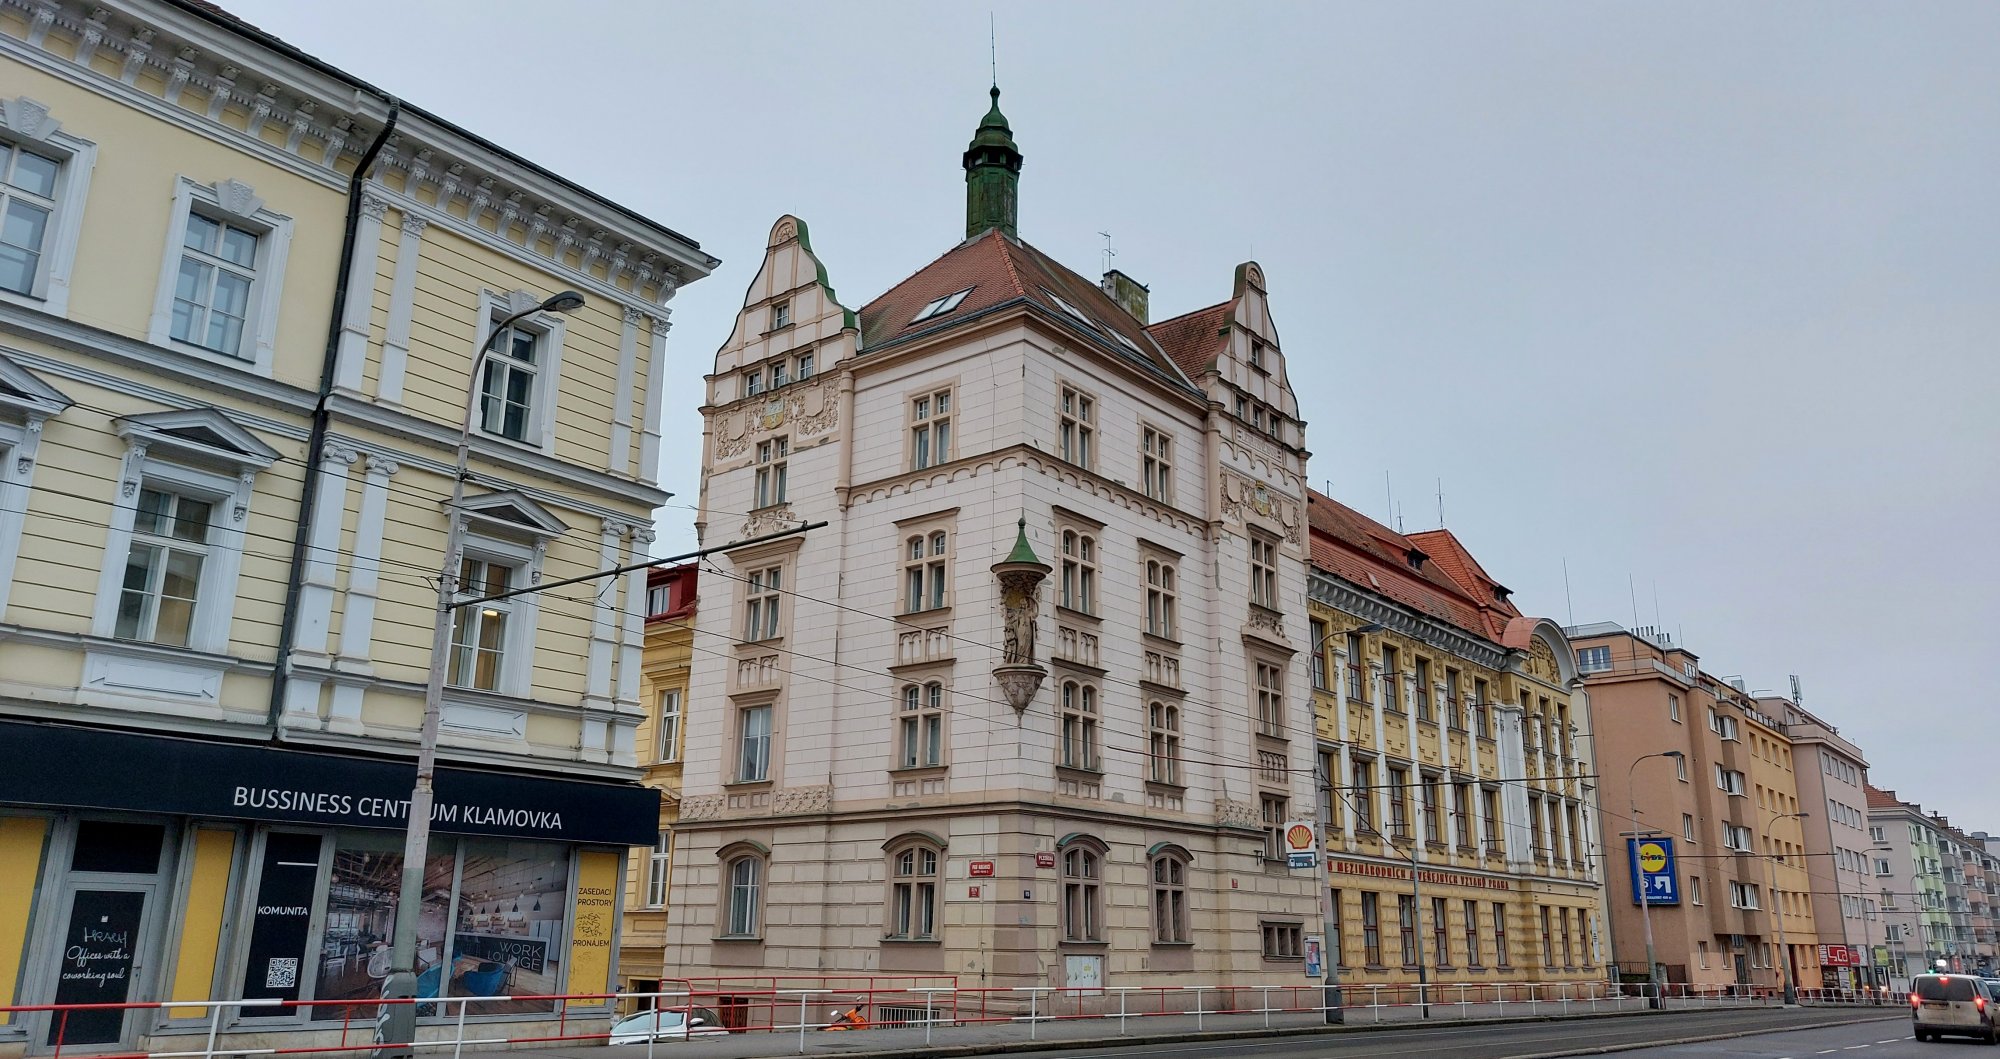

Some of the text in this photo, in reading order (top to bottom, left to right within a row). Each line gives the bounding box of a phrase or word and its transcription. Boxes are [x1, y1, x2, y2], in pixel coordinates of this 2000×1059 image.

[234, 786, 563, 830] BUSSINESS CENTUM KLAMOVKA
[578, 887, 612, 896] ZASEDACÍ
[577, 898, 613, 907] PROSTORY
[257, 905, 308, 916] KOMUNITA
[499, 941, 542, 958] WORK
[572, 938, 610, 947] PRONÁJEM
[66, 945, 103, 967] Offices
[103, 947, 122, 960] with
[62, 967, 126, 988] coworking soul
